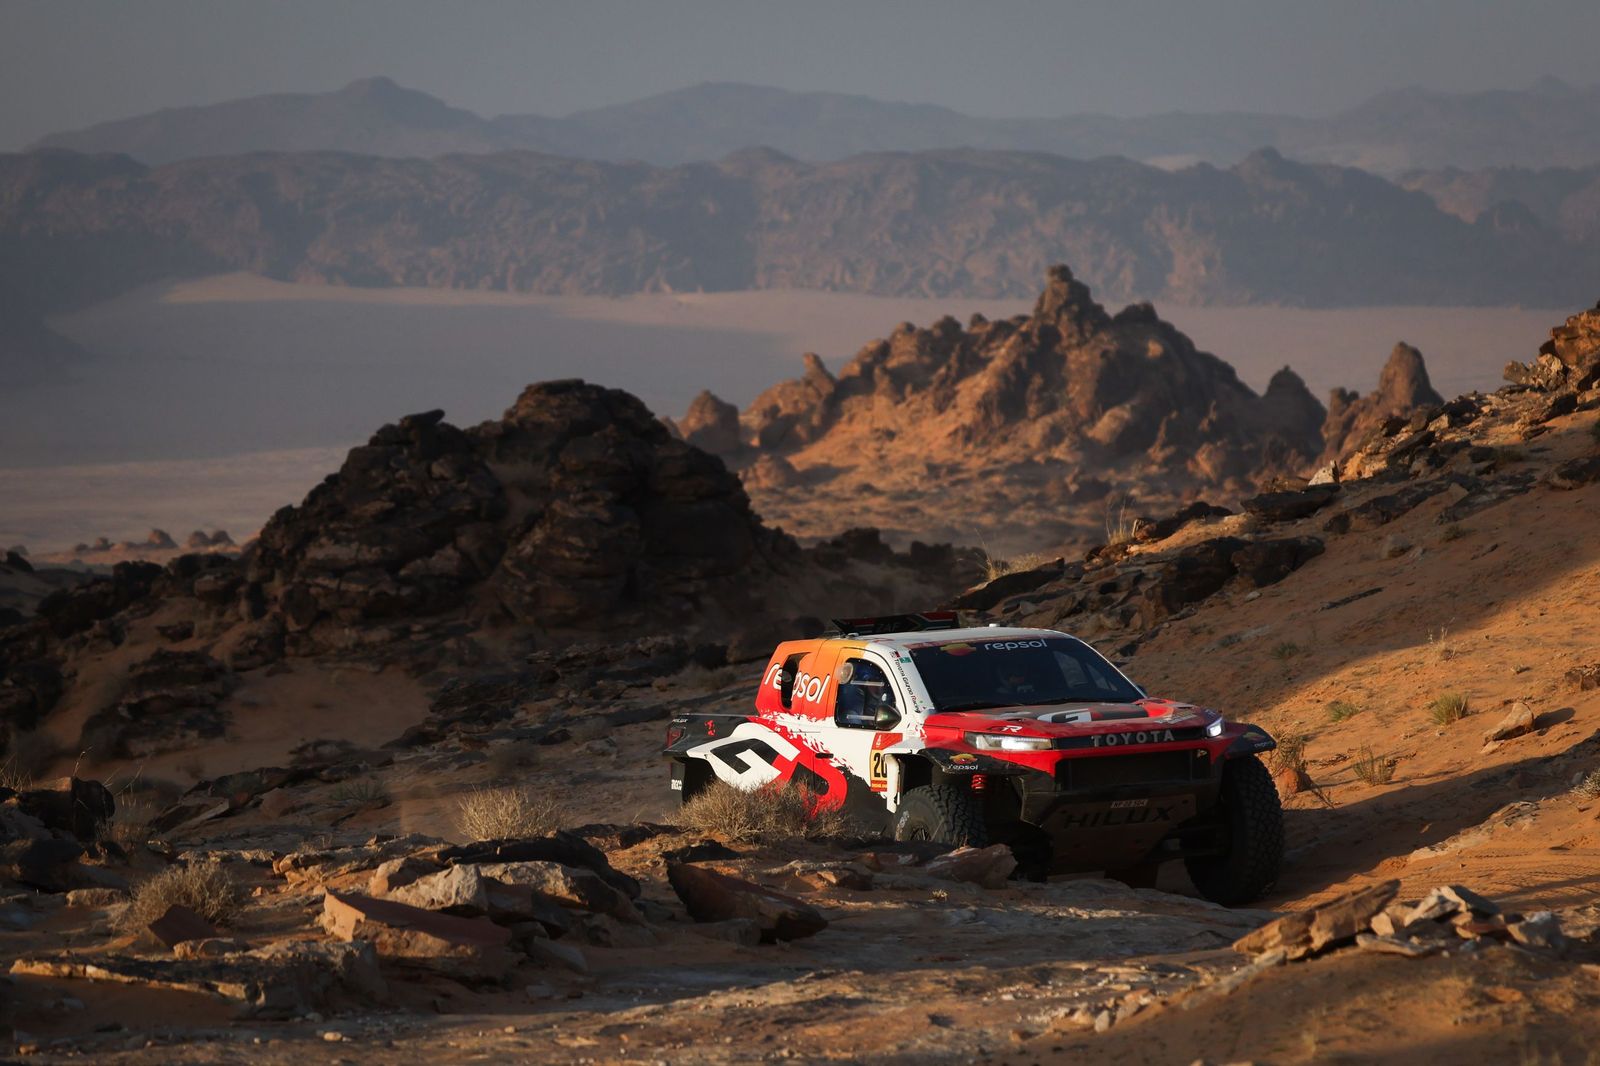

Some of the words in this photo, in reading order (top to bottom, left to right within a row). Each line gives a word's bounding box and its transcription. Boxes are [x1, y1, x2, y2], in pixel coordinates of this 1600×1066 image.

[984, 638, 1048, 651] repsol
[764, 663, 830, 704] repsol
[1090, 730, 1175, 748] TOYOTA
[947, 764, 979, 772] repsol
[1064, 808, 1172, 830] HILUX
